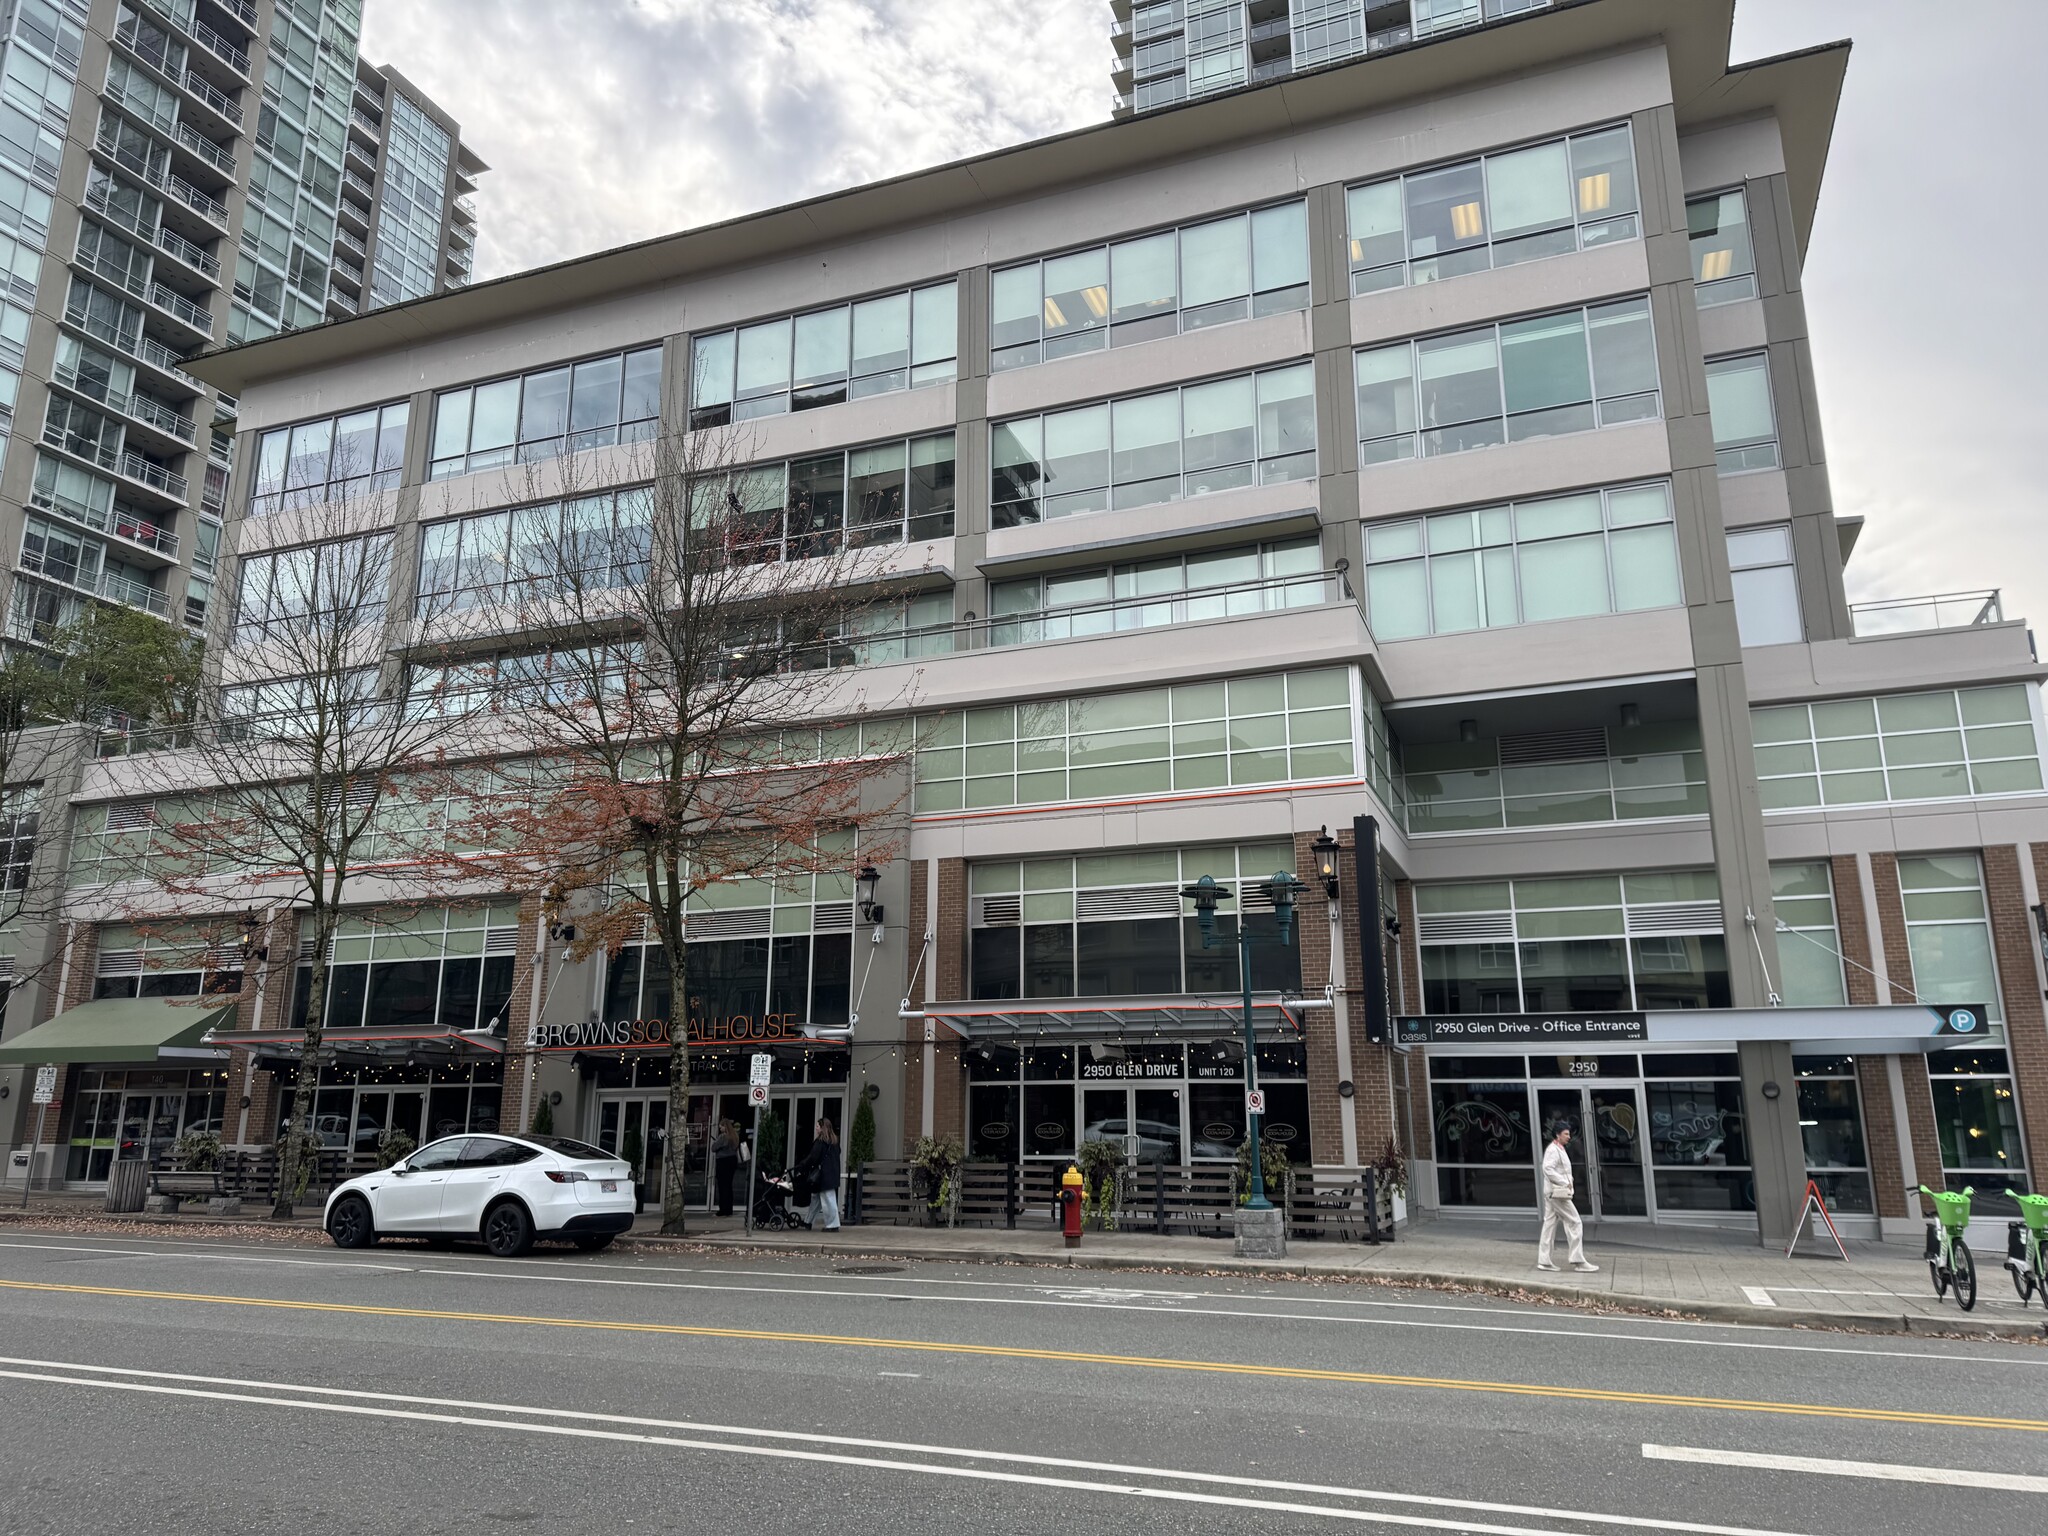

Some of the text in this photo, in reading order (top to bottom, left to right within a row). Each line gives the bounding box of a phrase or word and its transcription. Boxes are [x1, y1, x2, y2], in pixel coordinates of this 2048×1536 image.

[631, 1013, 797, 1043] SOALHOUSE
[1435, 1022, 1464, 1034] 2950
[1467, 1022, 1495, 1033] Glen
[1499, 1021, 1531, 1033] Drive
[1542, 1021, 1582, 1032] Office
[1586, 1020, 1641, 1032] Entrance
[1401, 1033, 1427, 1041] oasis
[690, 1059, 736, 1072] TRANCE
[1083, 1063, 1179, 1077] 2950 GLEN DRIVE
[1198, 1067, 1234, 1076] UNIT 120
[1568, 1061, 1598, 1073] 2950
